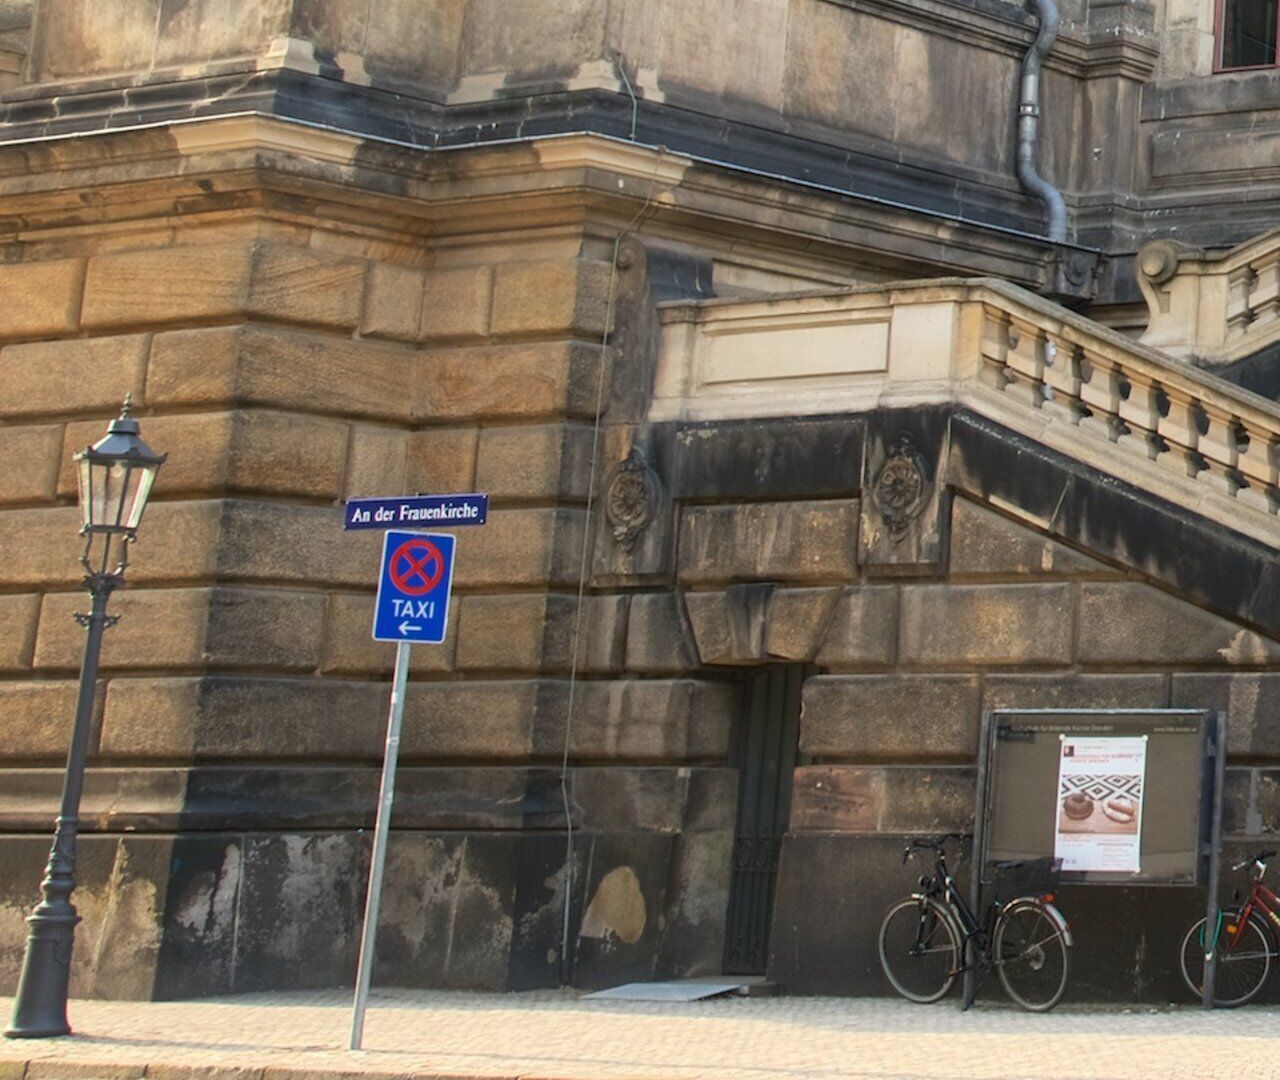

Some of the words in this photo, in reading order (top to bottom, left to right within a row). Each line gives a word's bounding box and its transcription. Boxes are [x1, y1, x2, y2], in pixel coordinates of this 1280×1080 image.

[351, 508, 371, 522] An
[374, 506, 395, 522] der
[399, 502, 478, 521] Frauenkirche
[391, 599, 435, 619] TAXI
